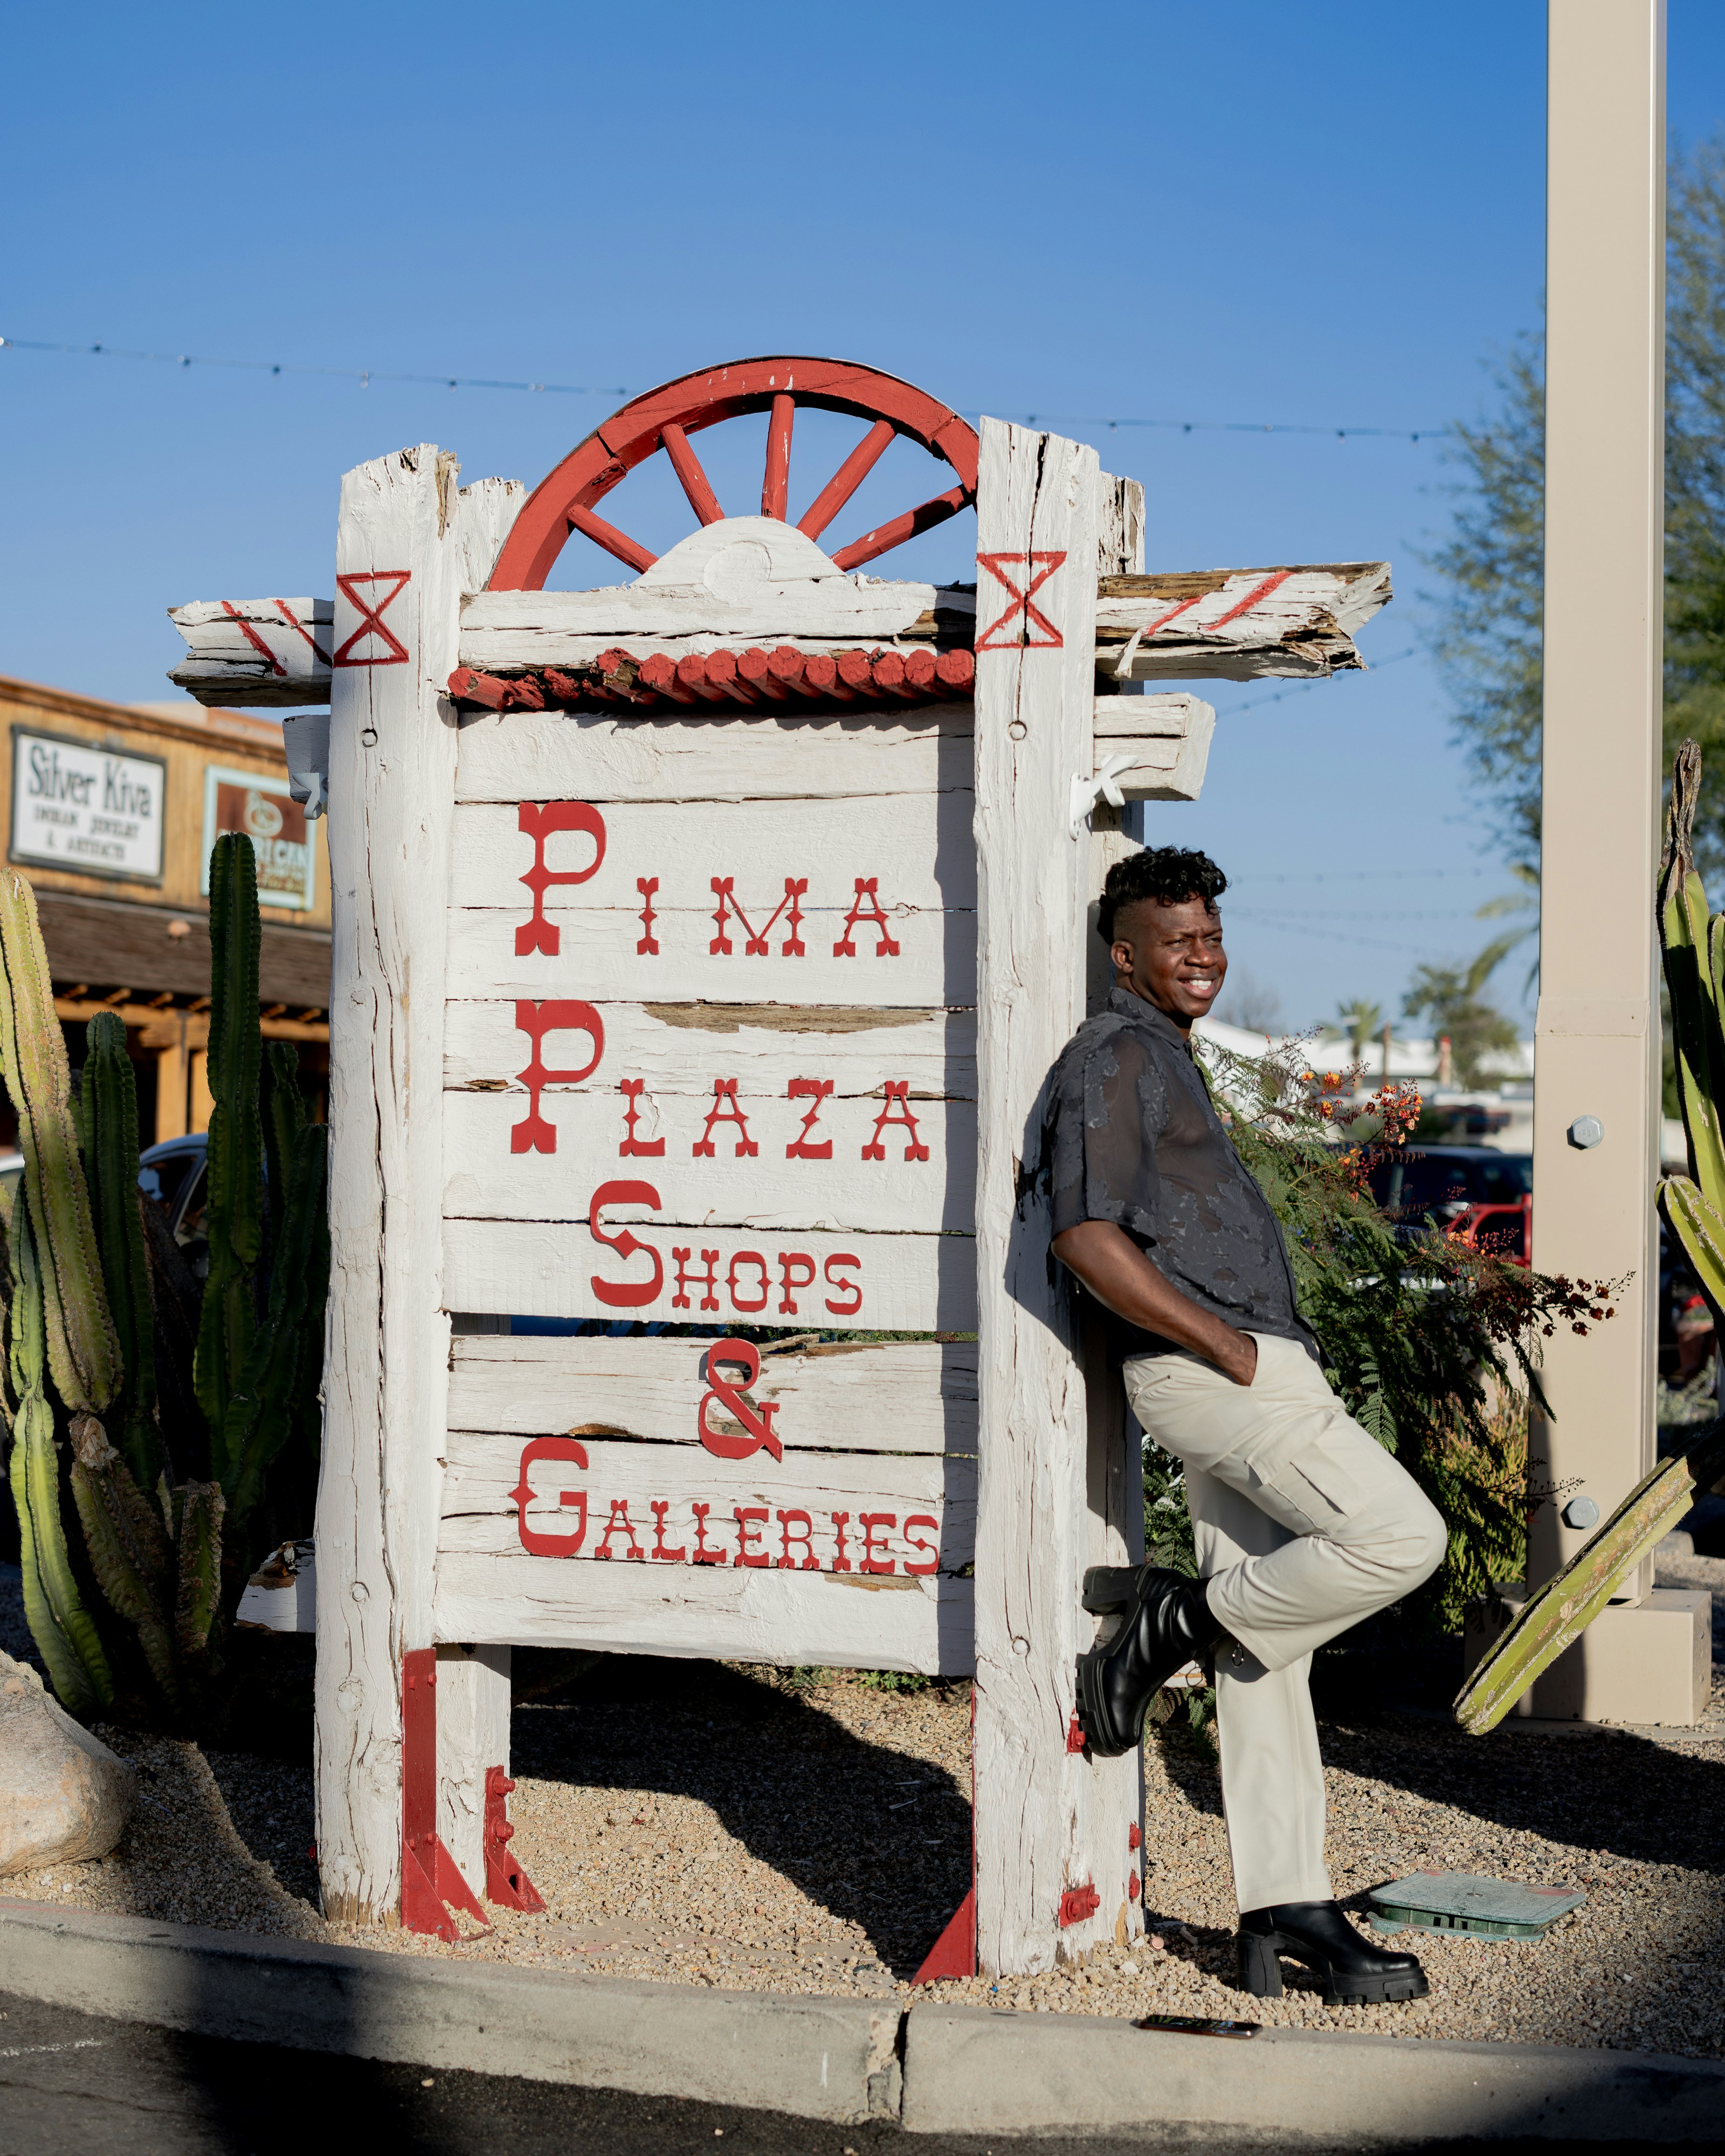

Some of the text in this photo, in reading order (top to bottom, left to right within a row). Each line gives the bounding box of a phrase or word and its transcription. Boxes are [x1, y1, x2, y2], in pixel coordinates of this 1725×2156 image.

[30, 744, 151, 818] Silver Kiva
[515, 801, 900, 957] PIMA
[510, 999, 929, 1160] PLAZA
[589, 1180, 862, 1315] SHOPS
[699, 1338, 783, 1463] &
[508, 1436, 940, 1575] GALLERIES
